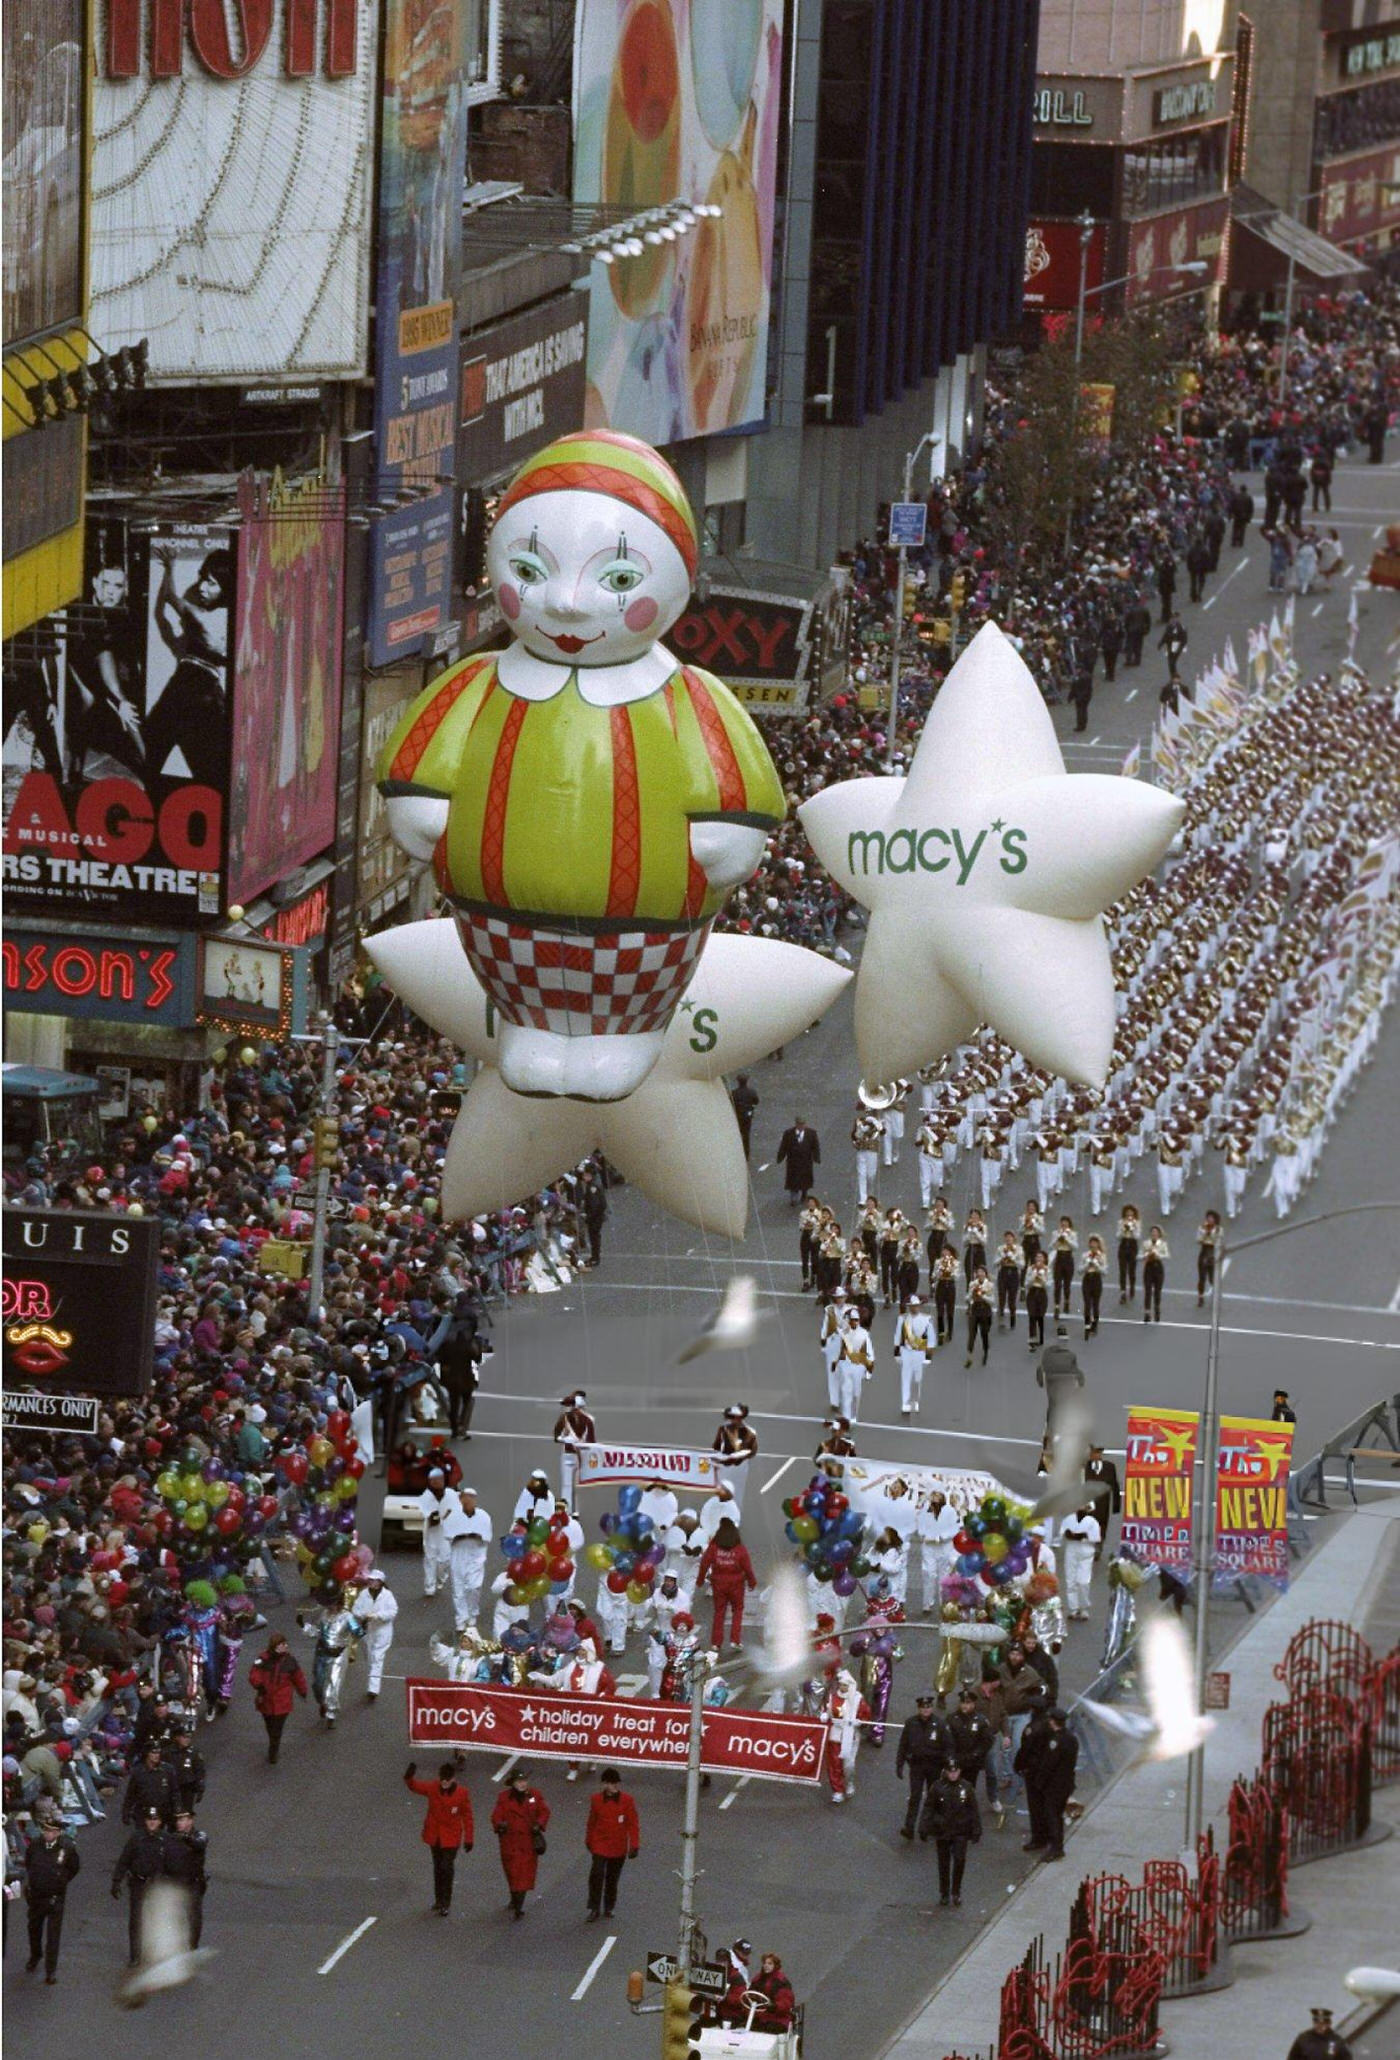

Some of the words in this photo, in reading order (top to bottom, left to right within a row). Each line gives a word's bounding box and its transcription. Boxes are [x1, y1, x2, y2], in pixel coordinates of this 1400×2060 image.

[18, 828, 107, 847] MUSICAL
[46, 858, 197, 896] THEATRE
[61, 1400, 93, 1418] ONLY
[1126, 1477, 1190, 1518] NEW
[1217, 1553, 1287, 1573] SQUARE
[416, 1704, 496, 1732] macy's
[539, 1707, 604, 1730] holiday
[613, 1713, 656, 1733] treat
[665, 1719, 690, 1735] for
[520, 1726, 588, 1745] children
[597, 1733, 690, 1754] everywher
[727, 1735, 816, 1765] macy's
